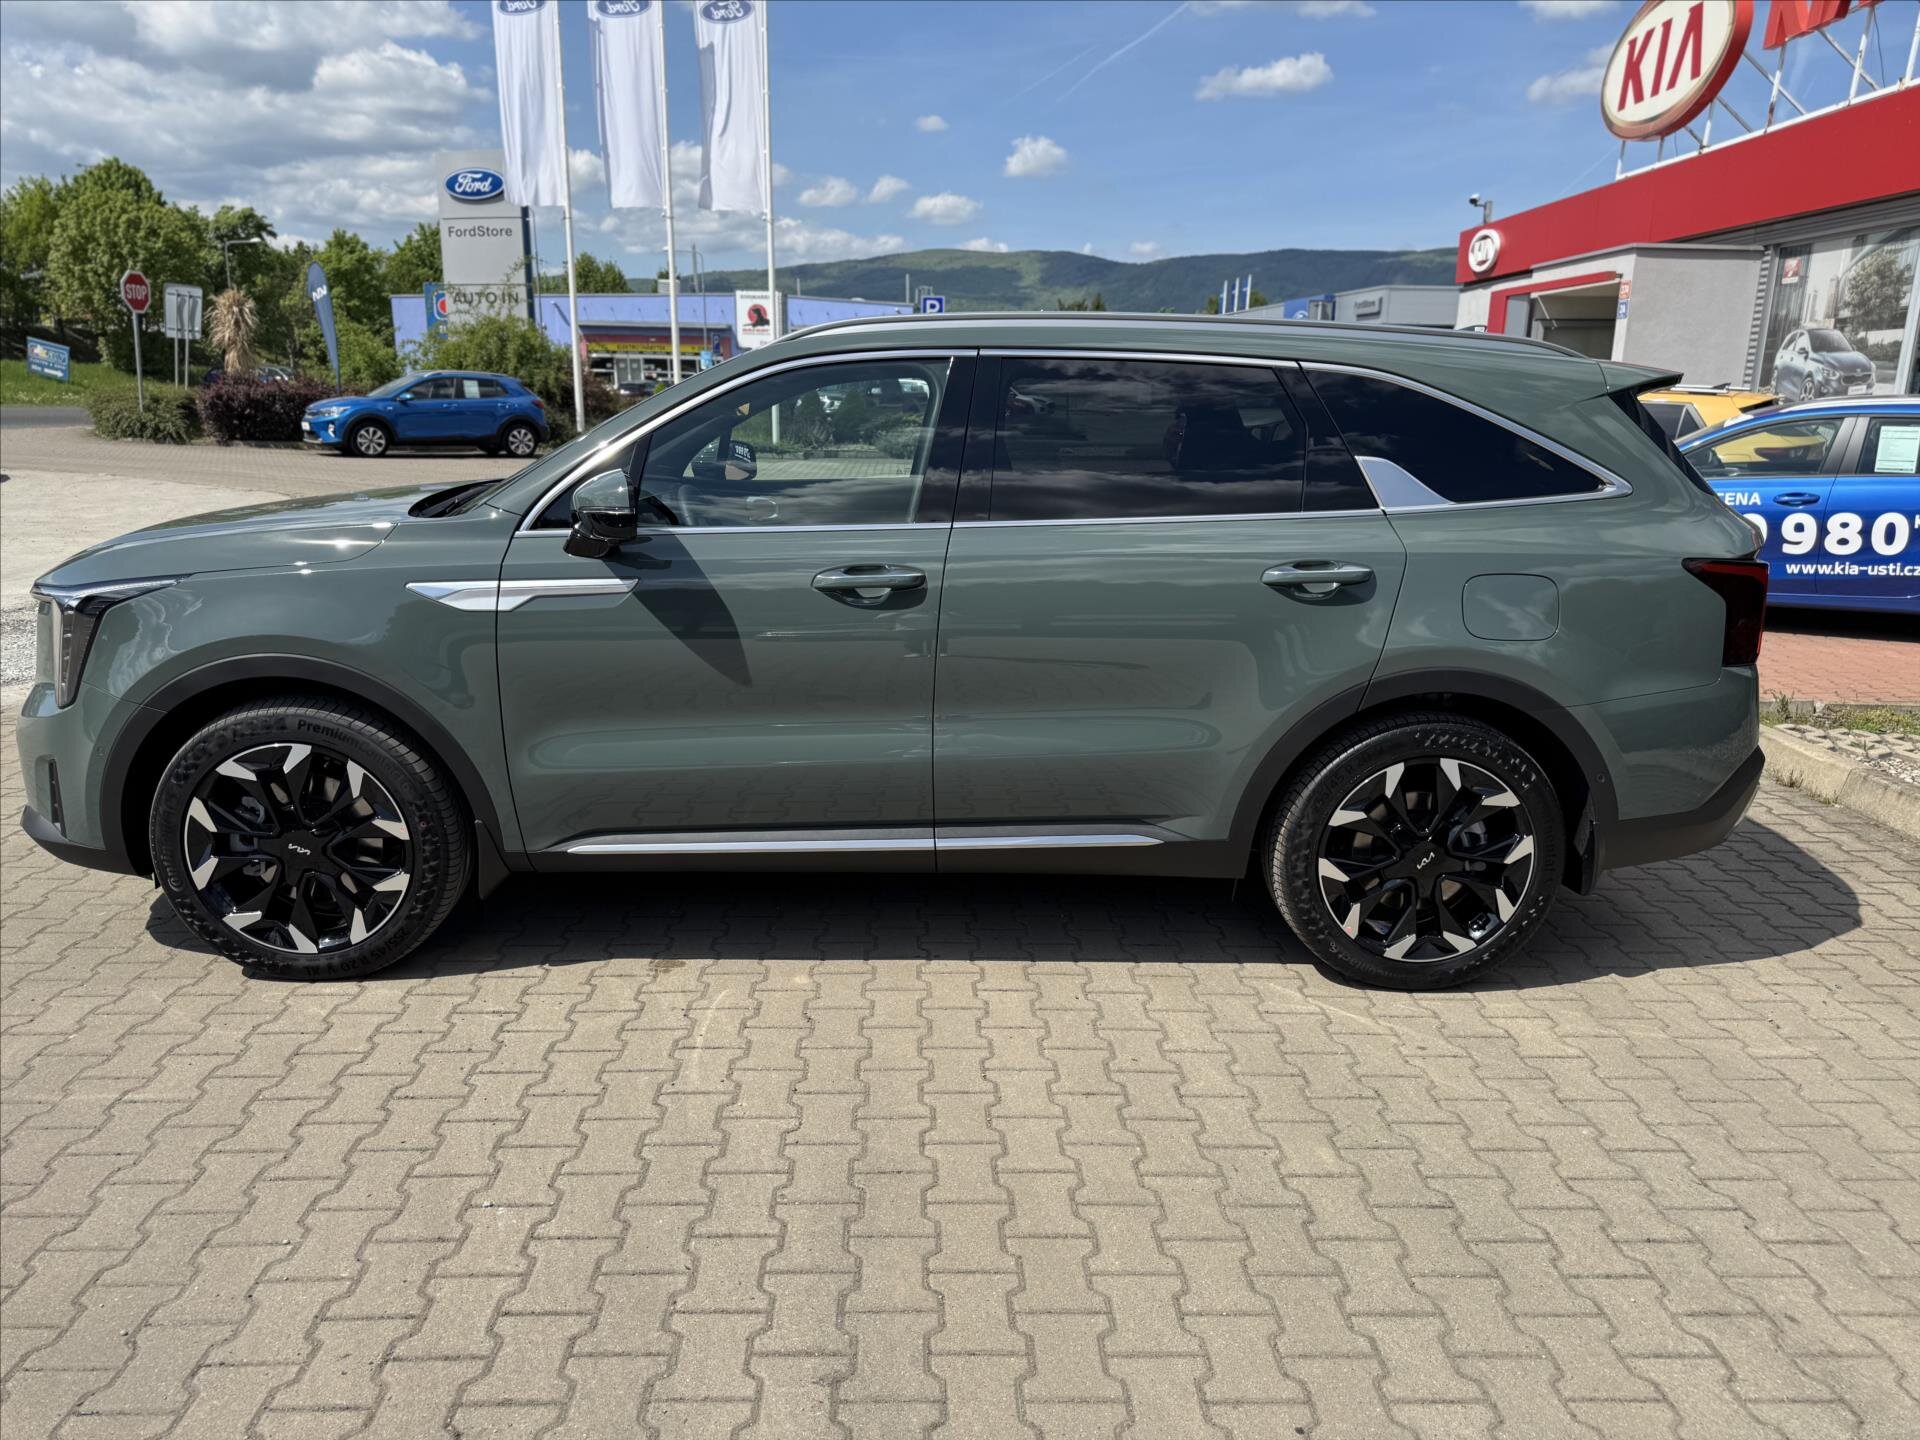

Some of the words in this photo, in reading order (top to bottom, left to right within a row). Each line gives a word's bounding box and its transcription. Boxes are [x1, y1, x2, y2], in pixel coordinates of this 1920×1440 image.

[1617, 1, 1704, 112] KIA
[455, 172, 493, 193] Ford
[448, 226, 513, 237] FordStore
[125, 283, 147, 300] STOP
[453, 292, 498, 305] AUTO
[501, 291, 519, 304] IN
[926, 299, 940, 314] P
[1717, 492, 1761, 506] ENA
[1786, 562, 1920, 577] www.kia-usti.cz
